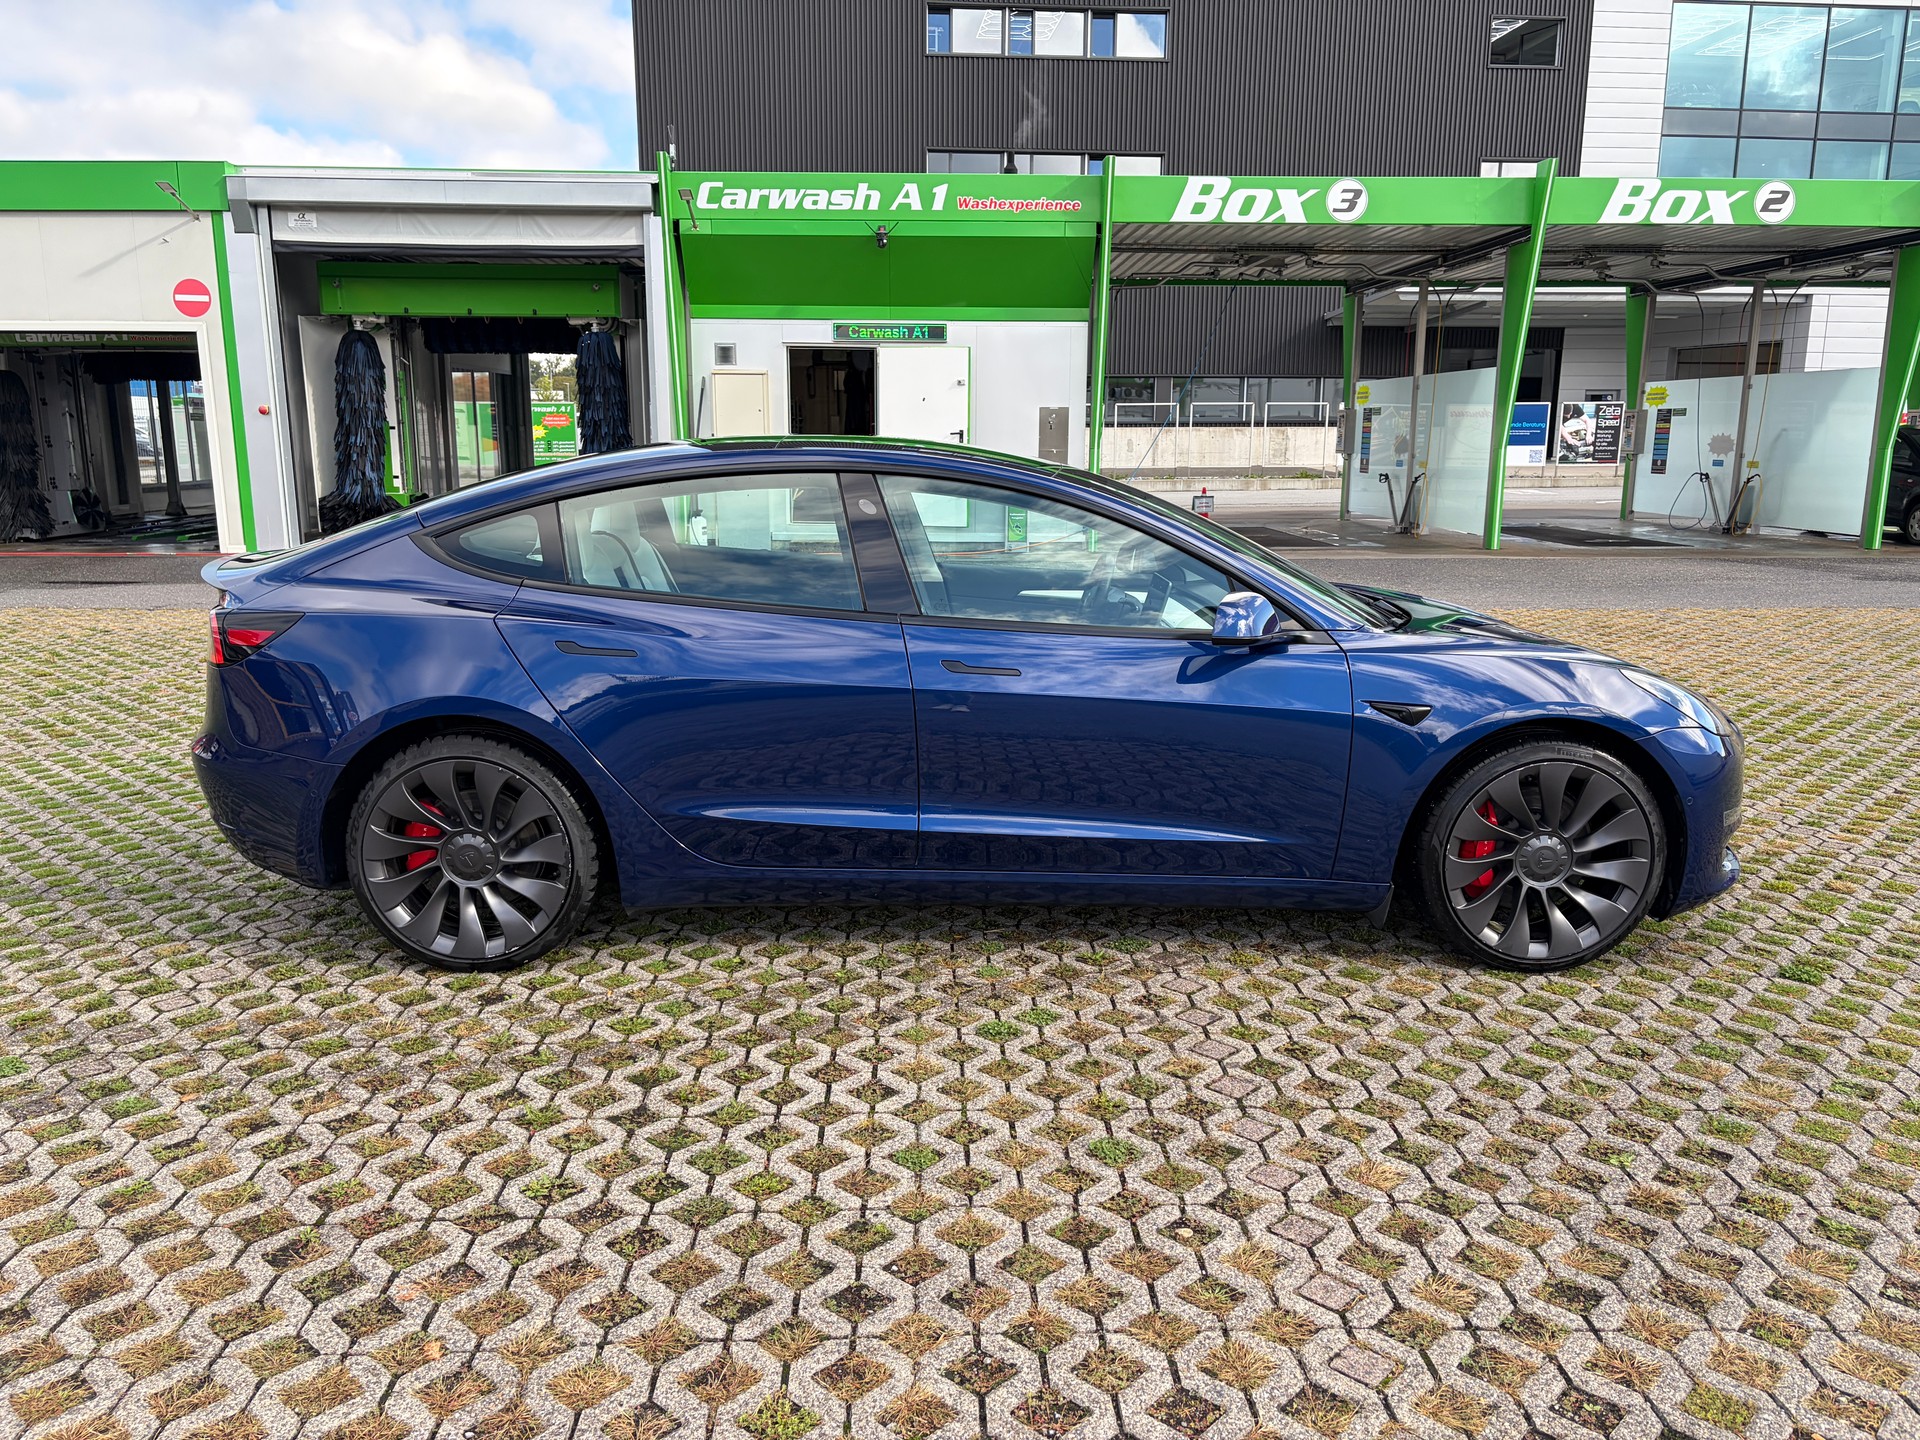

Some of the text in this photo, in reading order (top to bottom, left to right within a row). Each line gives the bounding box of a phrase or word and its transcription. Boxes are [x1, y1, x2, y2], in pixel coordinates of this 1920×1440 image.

[696, 181, 881, 210] Carwash
[1168, 176, 1363, 223] Box 3
[1596, 178, 1790, 224] Box 2
[957, 196, 1082, 212] Washexperience
[848, 325, 930, 338] Carwash A1
[1598, 405, 1621, 416] Zeta
[1597, 418, 1620, 428] Speed
